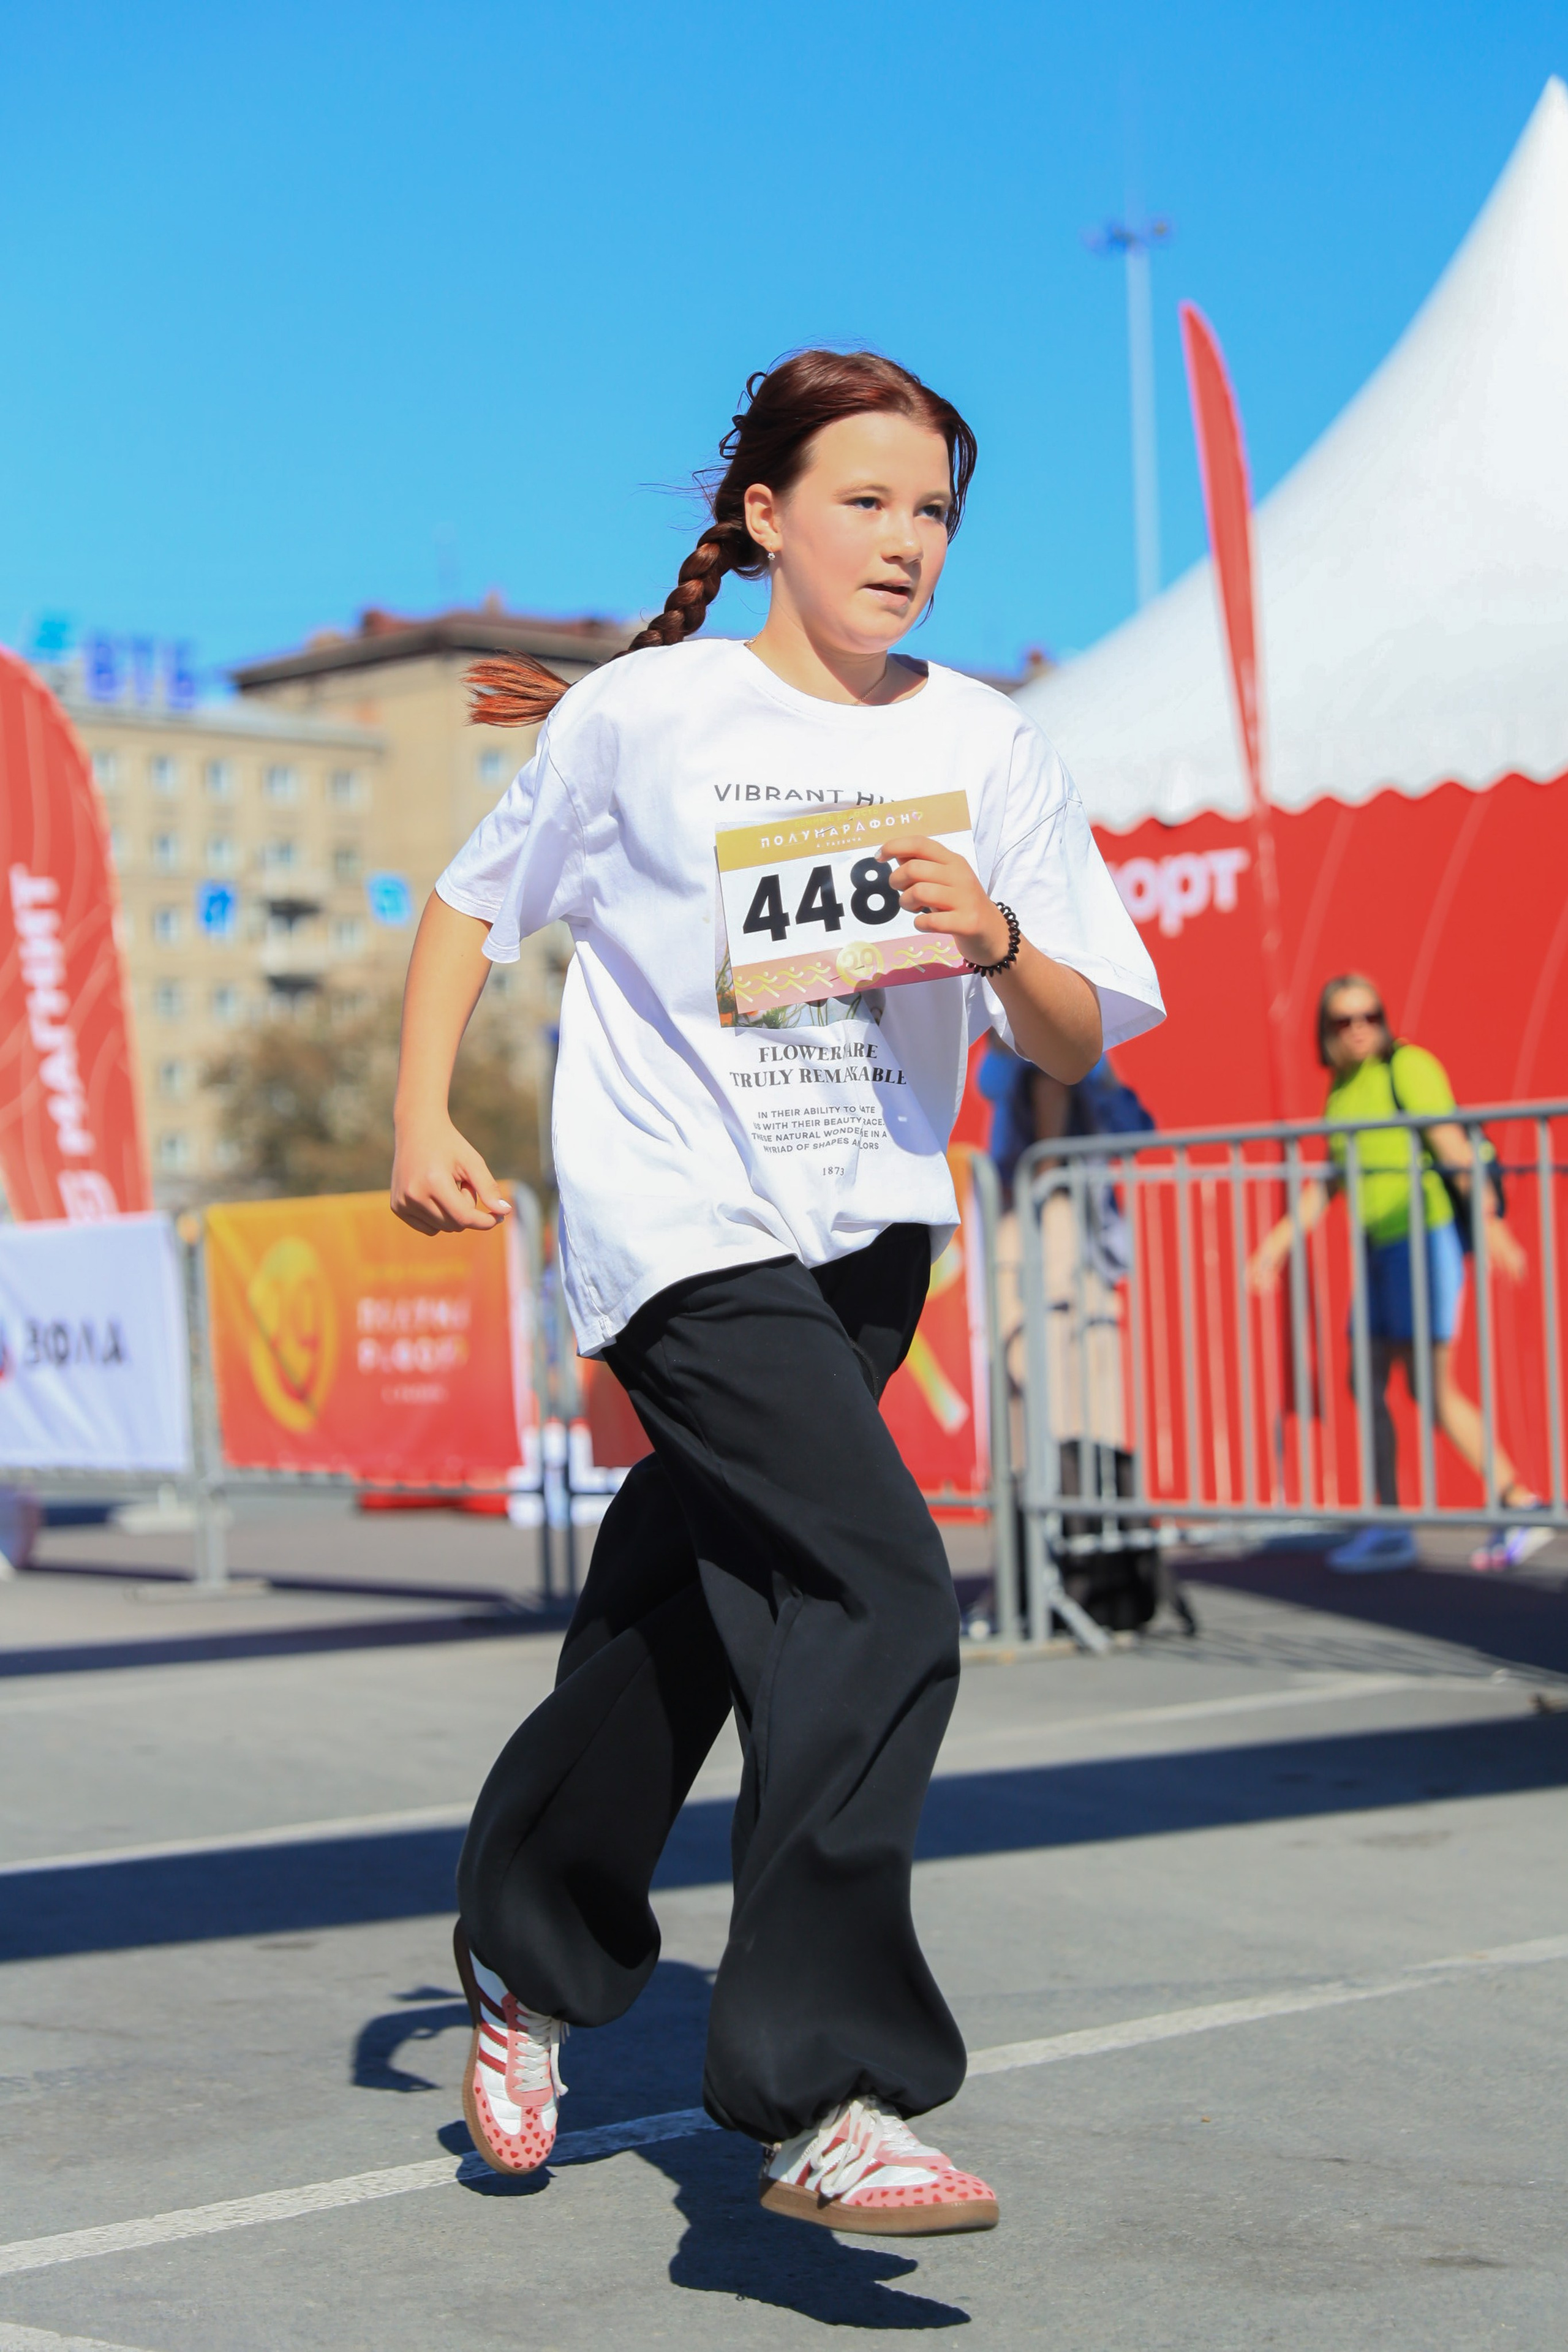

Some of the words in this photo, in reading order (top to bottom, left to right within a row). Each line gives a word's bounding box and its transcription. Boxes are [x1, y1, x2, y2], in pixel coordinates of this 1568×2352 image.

[714, 783, 844, 804] VIBRANT
[760, 813, 910, 848] ПОЛУМАРАФОН
[742, 856, 903, 942] 448
[758, 1044, 847, 1063] FLOWER
[729, 1069, 794, 1088] TRULY
[771, 1108, 801, 1118] THEIR
[804, 1104, 840, 1115] ABILITY
[791, 1120, 820, 1128] THEIR
[824, 1116, 862, 1126] BEAUTY
[752, 1133, 772, 1142] THESE
[775, 1131, 821, 1142] NATURAL
[824, 1127, 860, 1137] WONDE
[813, 1137, 850, 1150] SHAPES
[823, 1166, 845, 1176] 1873
